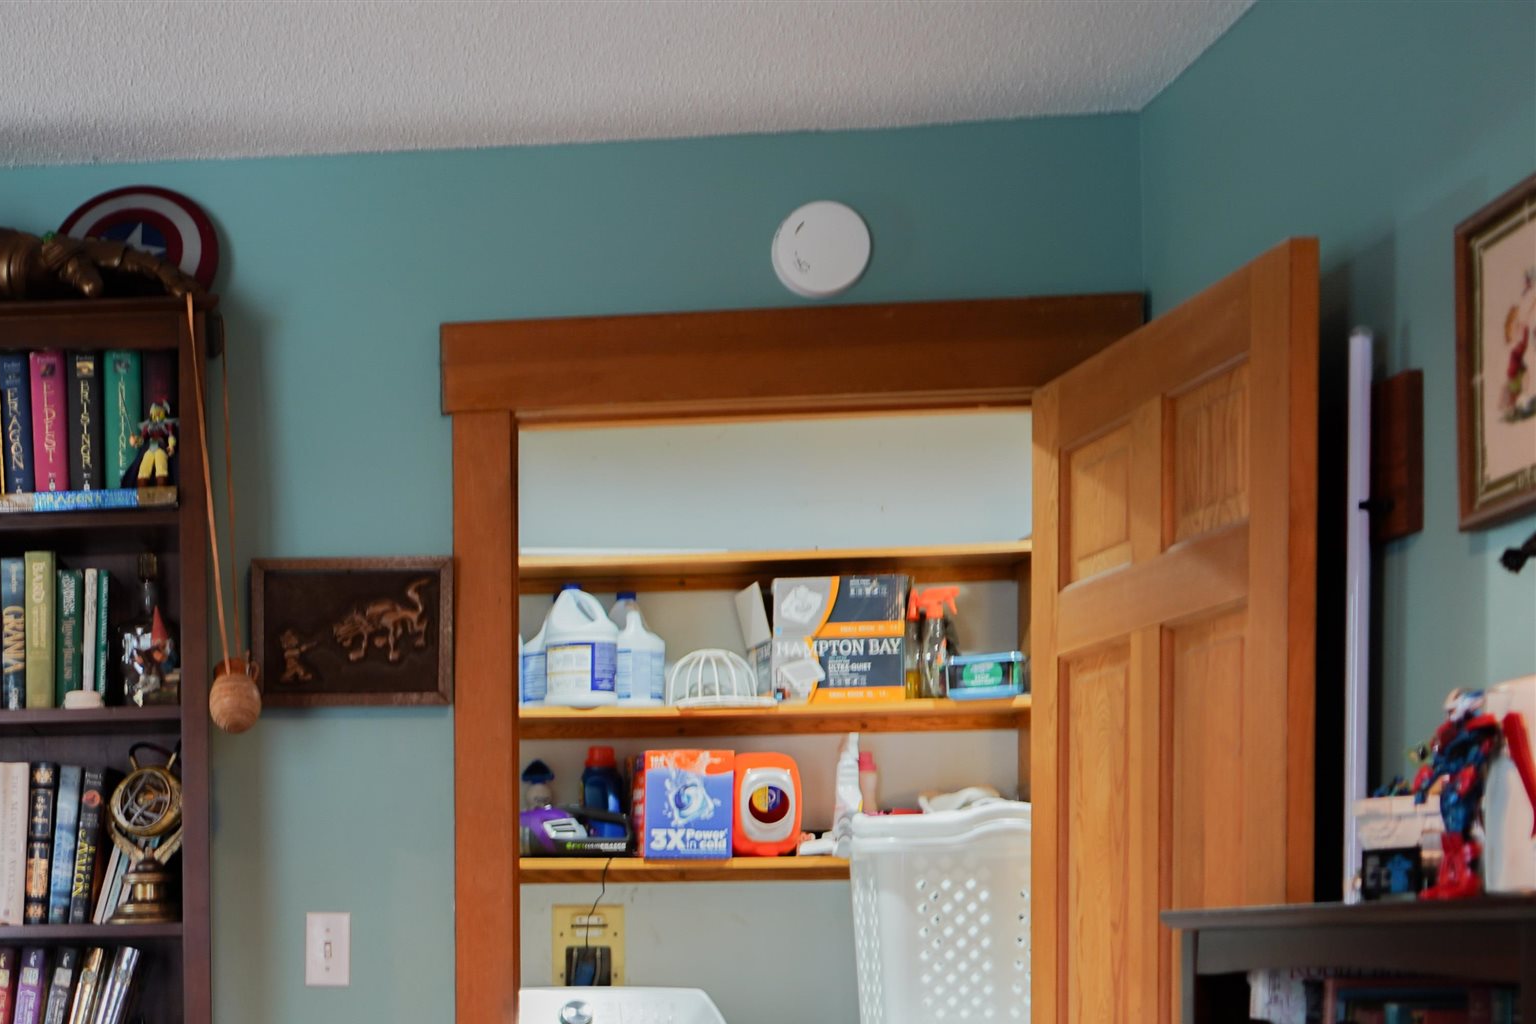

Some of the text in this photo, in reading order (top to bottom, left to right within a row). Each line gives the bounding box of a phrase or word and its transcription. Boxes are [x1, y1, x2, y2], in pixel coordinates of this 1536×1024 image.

[7, 388, 25, 470] ERAGON
[31, 561, 46, 603] BARD
[3, 605, 26, 674] GRANIA
[776, 636, 902, 658] HAMPTON BAY
[650, 828, 728, 852] 3X Power
[699, 839, 728, 852] cold
